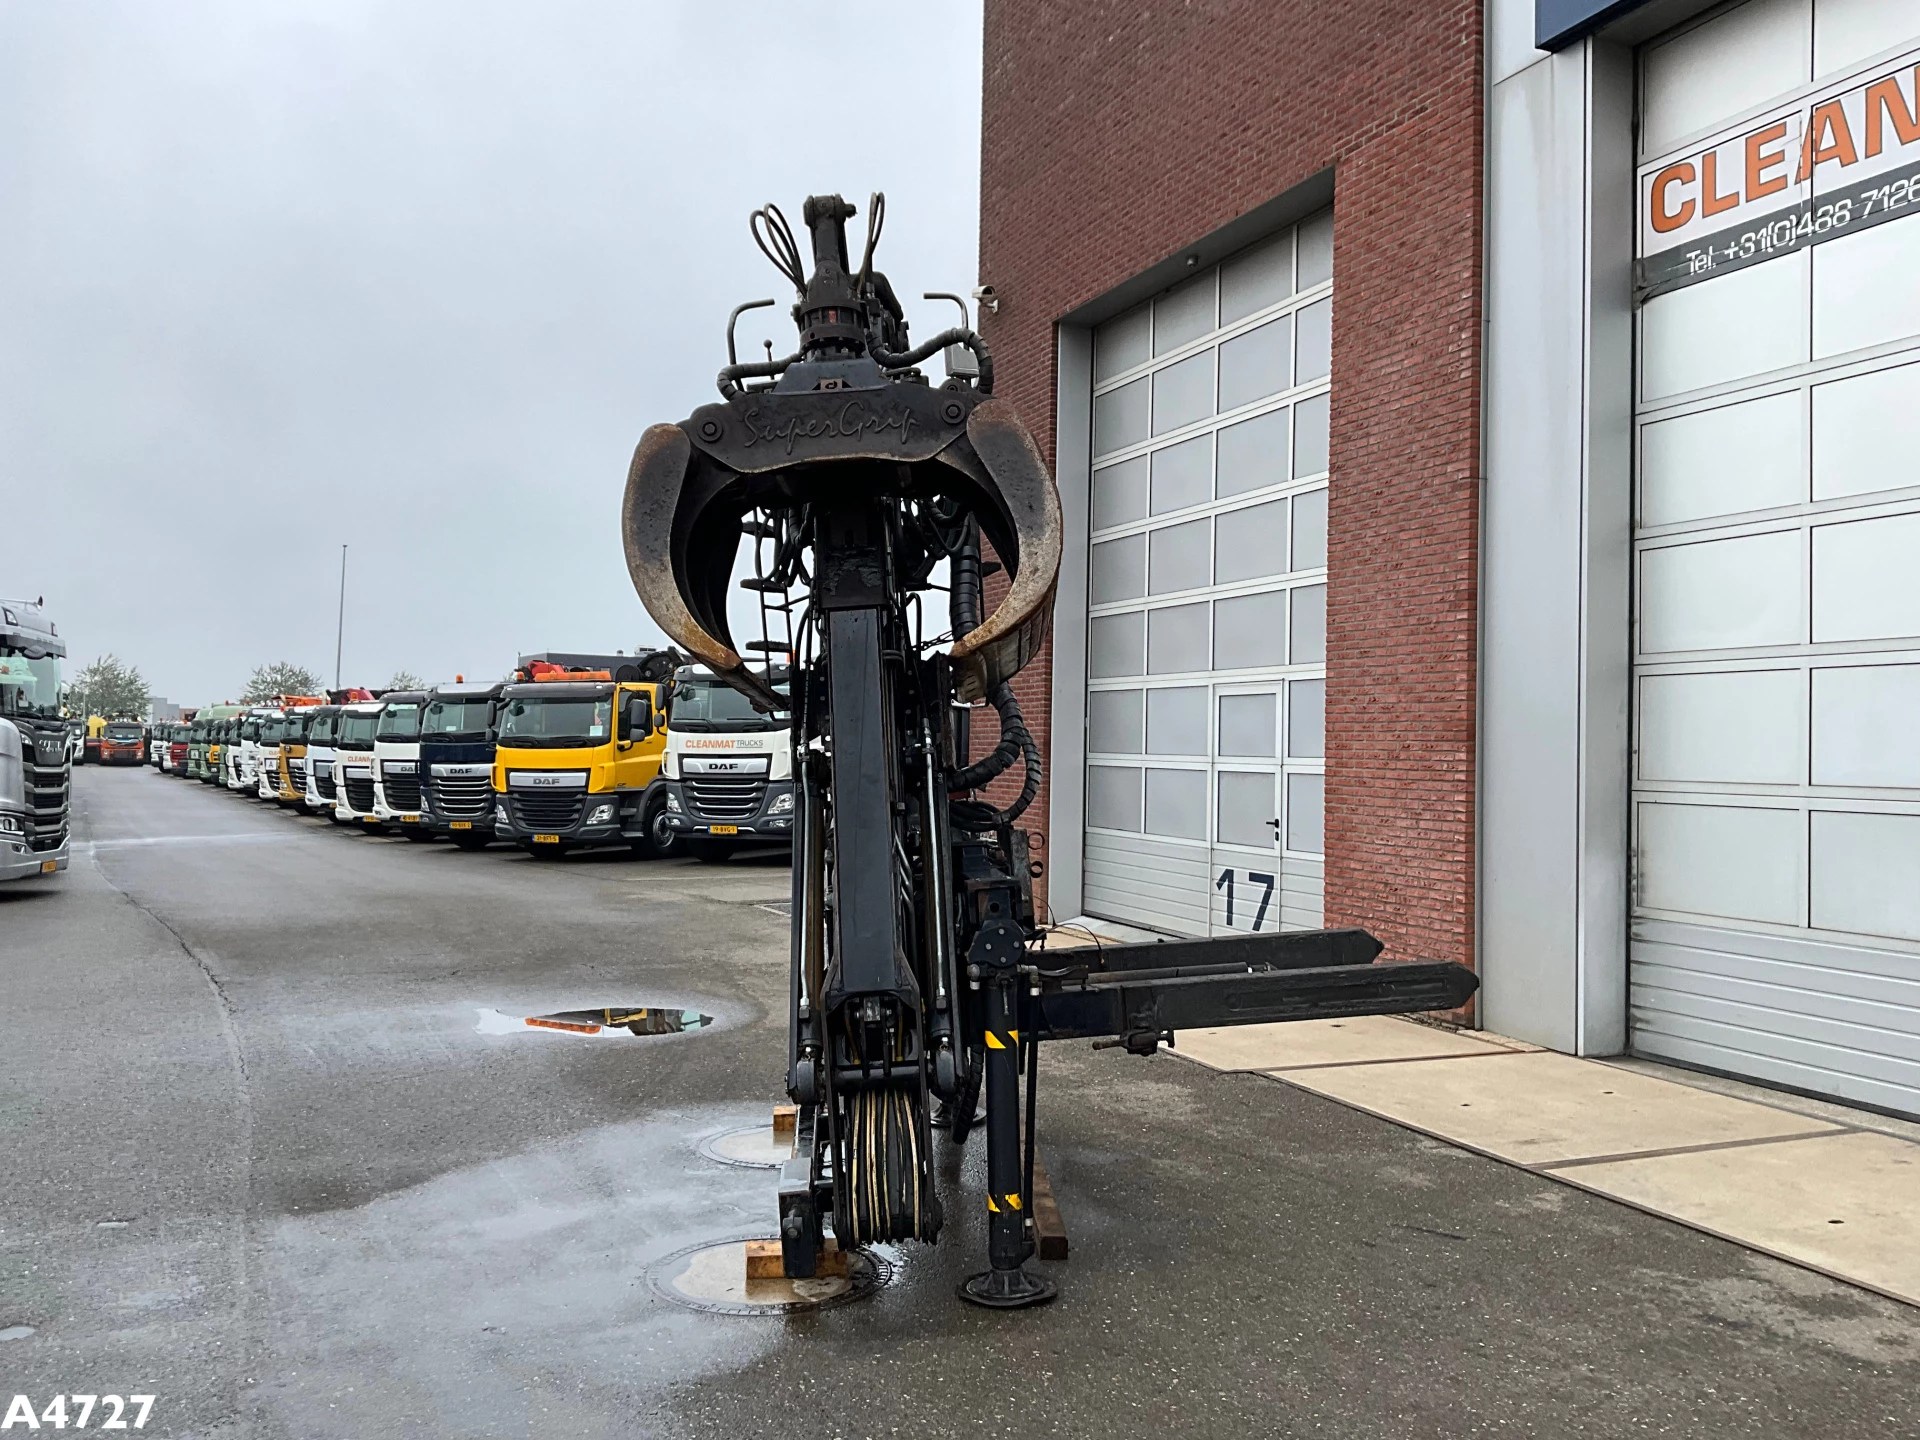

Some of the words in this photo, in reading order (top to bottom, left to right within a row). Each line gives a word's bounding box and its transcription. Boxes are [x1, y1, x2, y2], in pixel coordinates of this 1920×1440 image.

[1651, 64, 1920, 234] CLEAN
[1686, 245, 1717, 275] Tel.
[743, 401, 920, 455] SuperGrip
[685, 739, 736, 749] CLEANMAT
[736, 739, 764, 748] TRUCKS
[1216, 868, 1275, 932] 17
